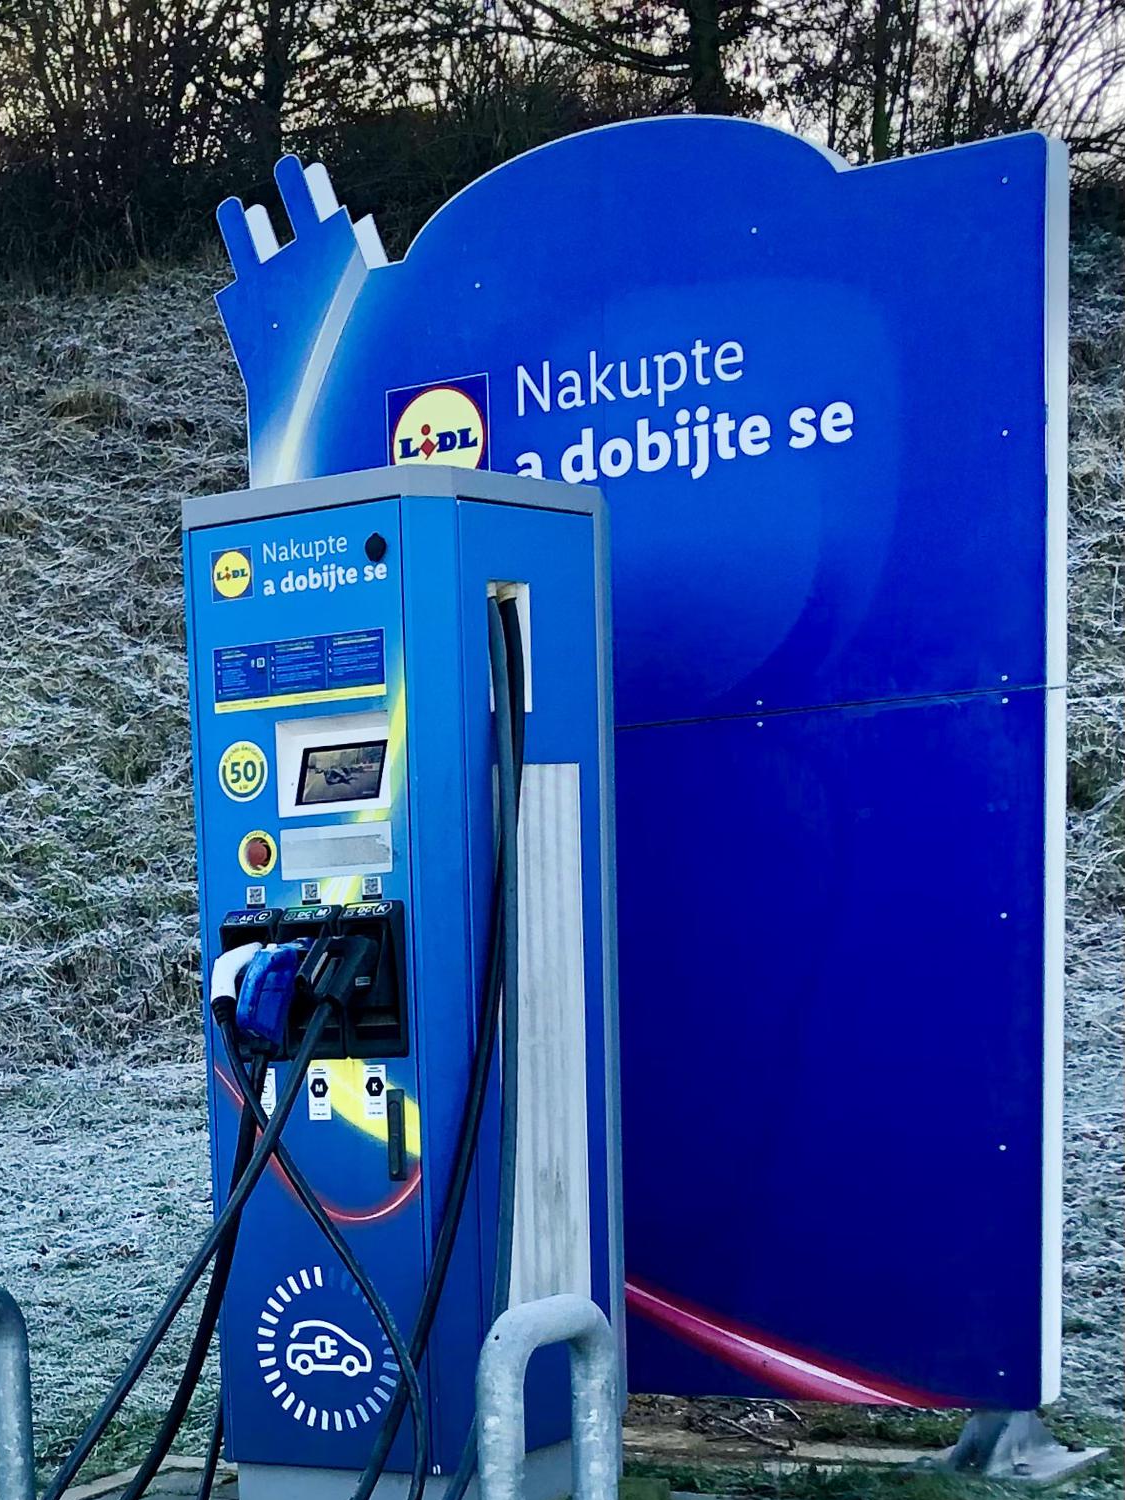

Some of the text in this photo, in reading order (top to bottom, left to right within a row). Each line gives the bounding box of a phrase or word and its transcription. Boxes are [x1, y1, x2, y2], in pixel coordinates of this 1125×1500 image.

[517, 340, 745, 416] Nakupte
[515, 400, 854, 484] a dobijte se
[262, 536, 348, 564] Nakupte
[263, 562, 387, 596] a dobijte se
[230, 760, 257, 784] 50
[356, 903, 386, 914] DC K
[315, 1083, 323, 1092] M
[371, 1081, 379, 1092] K
